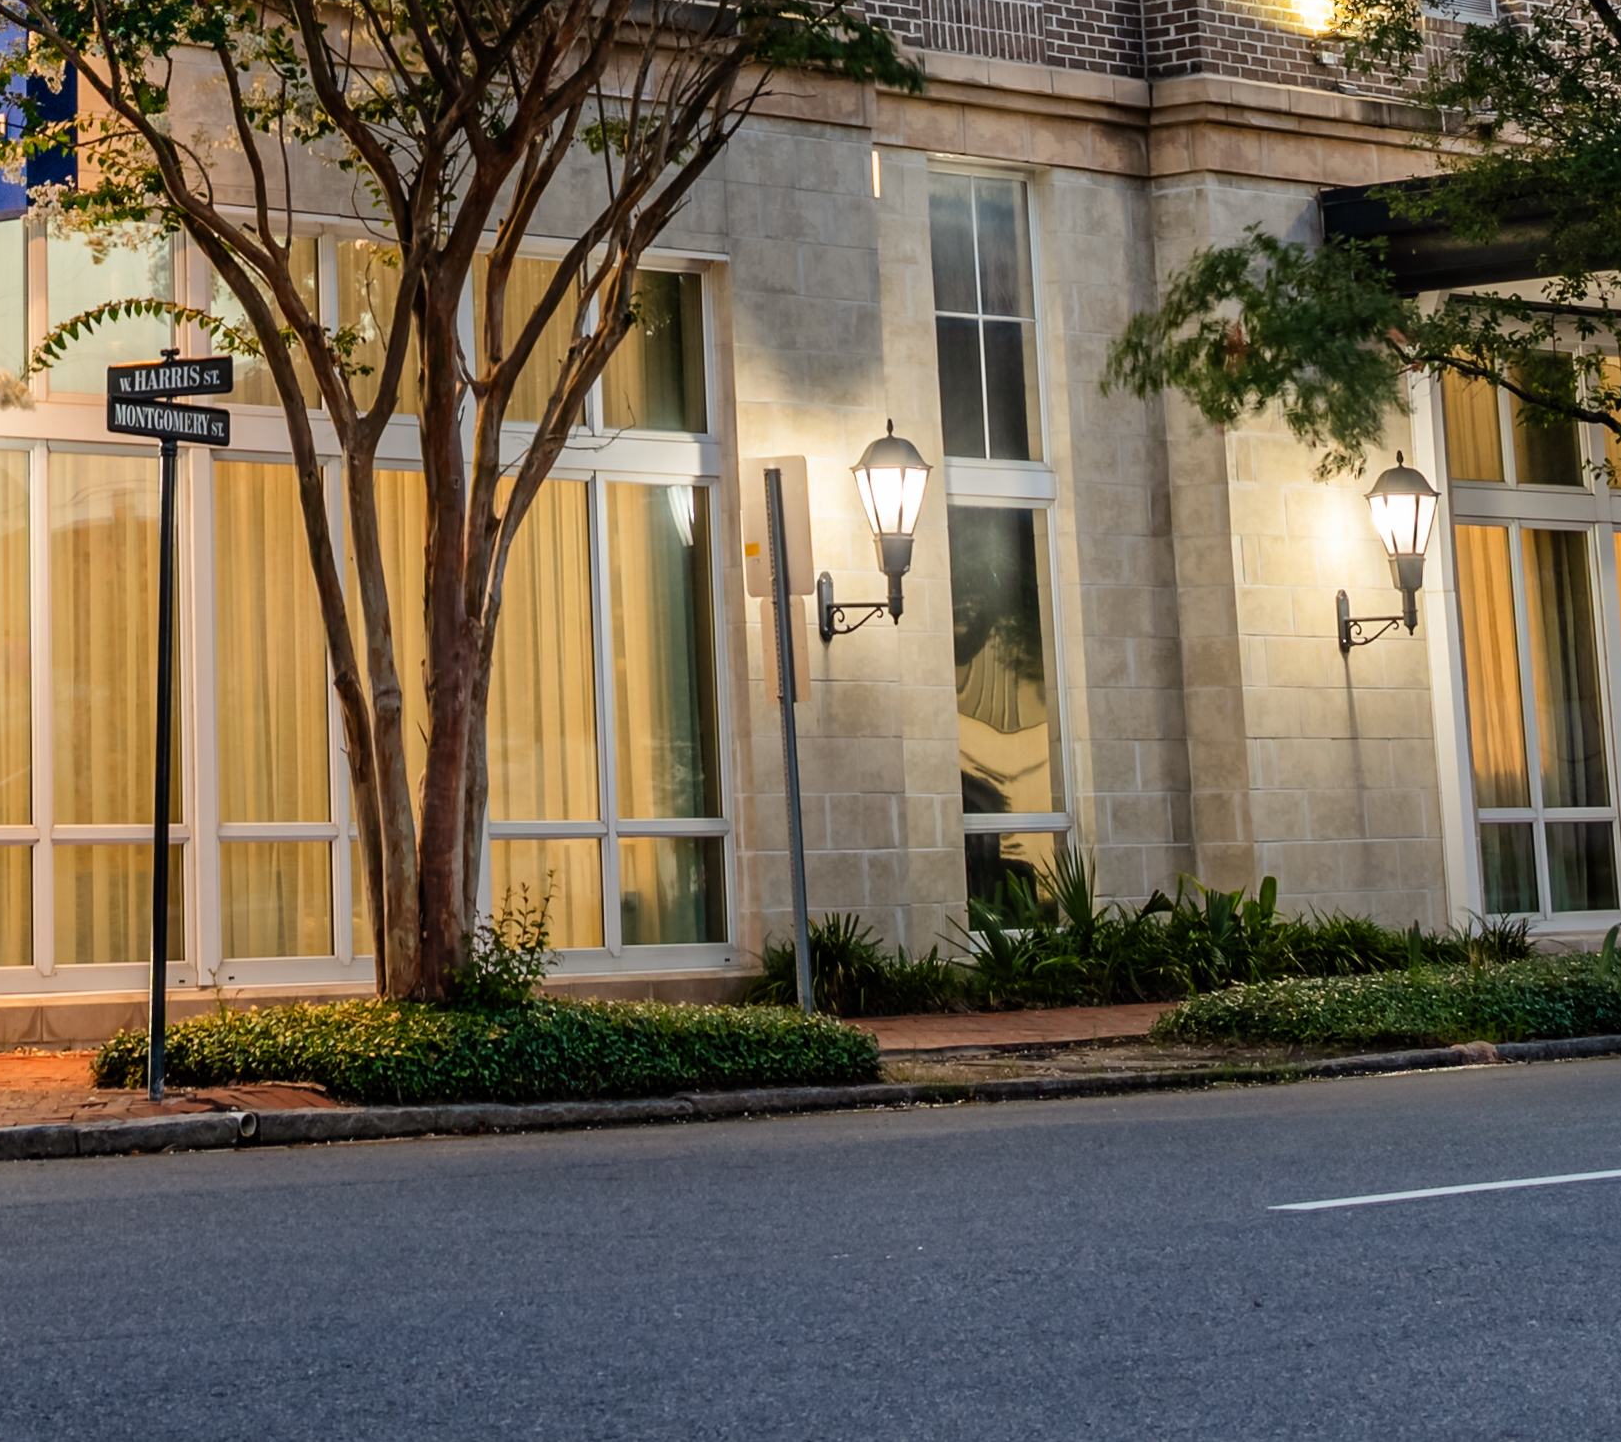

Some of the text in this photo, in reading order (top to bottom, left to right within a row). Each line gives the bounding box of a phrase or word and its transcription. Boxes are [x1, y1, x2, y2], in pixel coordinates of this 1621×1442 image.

[119, 365, 220, 392] W. HARRIS ST.
[114, 403, 225, 437] MONTGOMERY ST.
